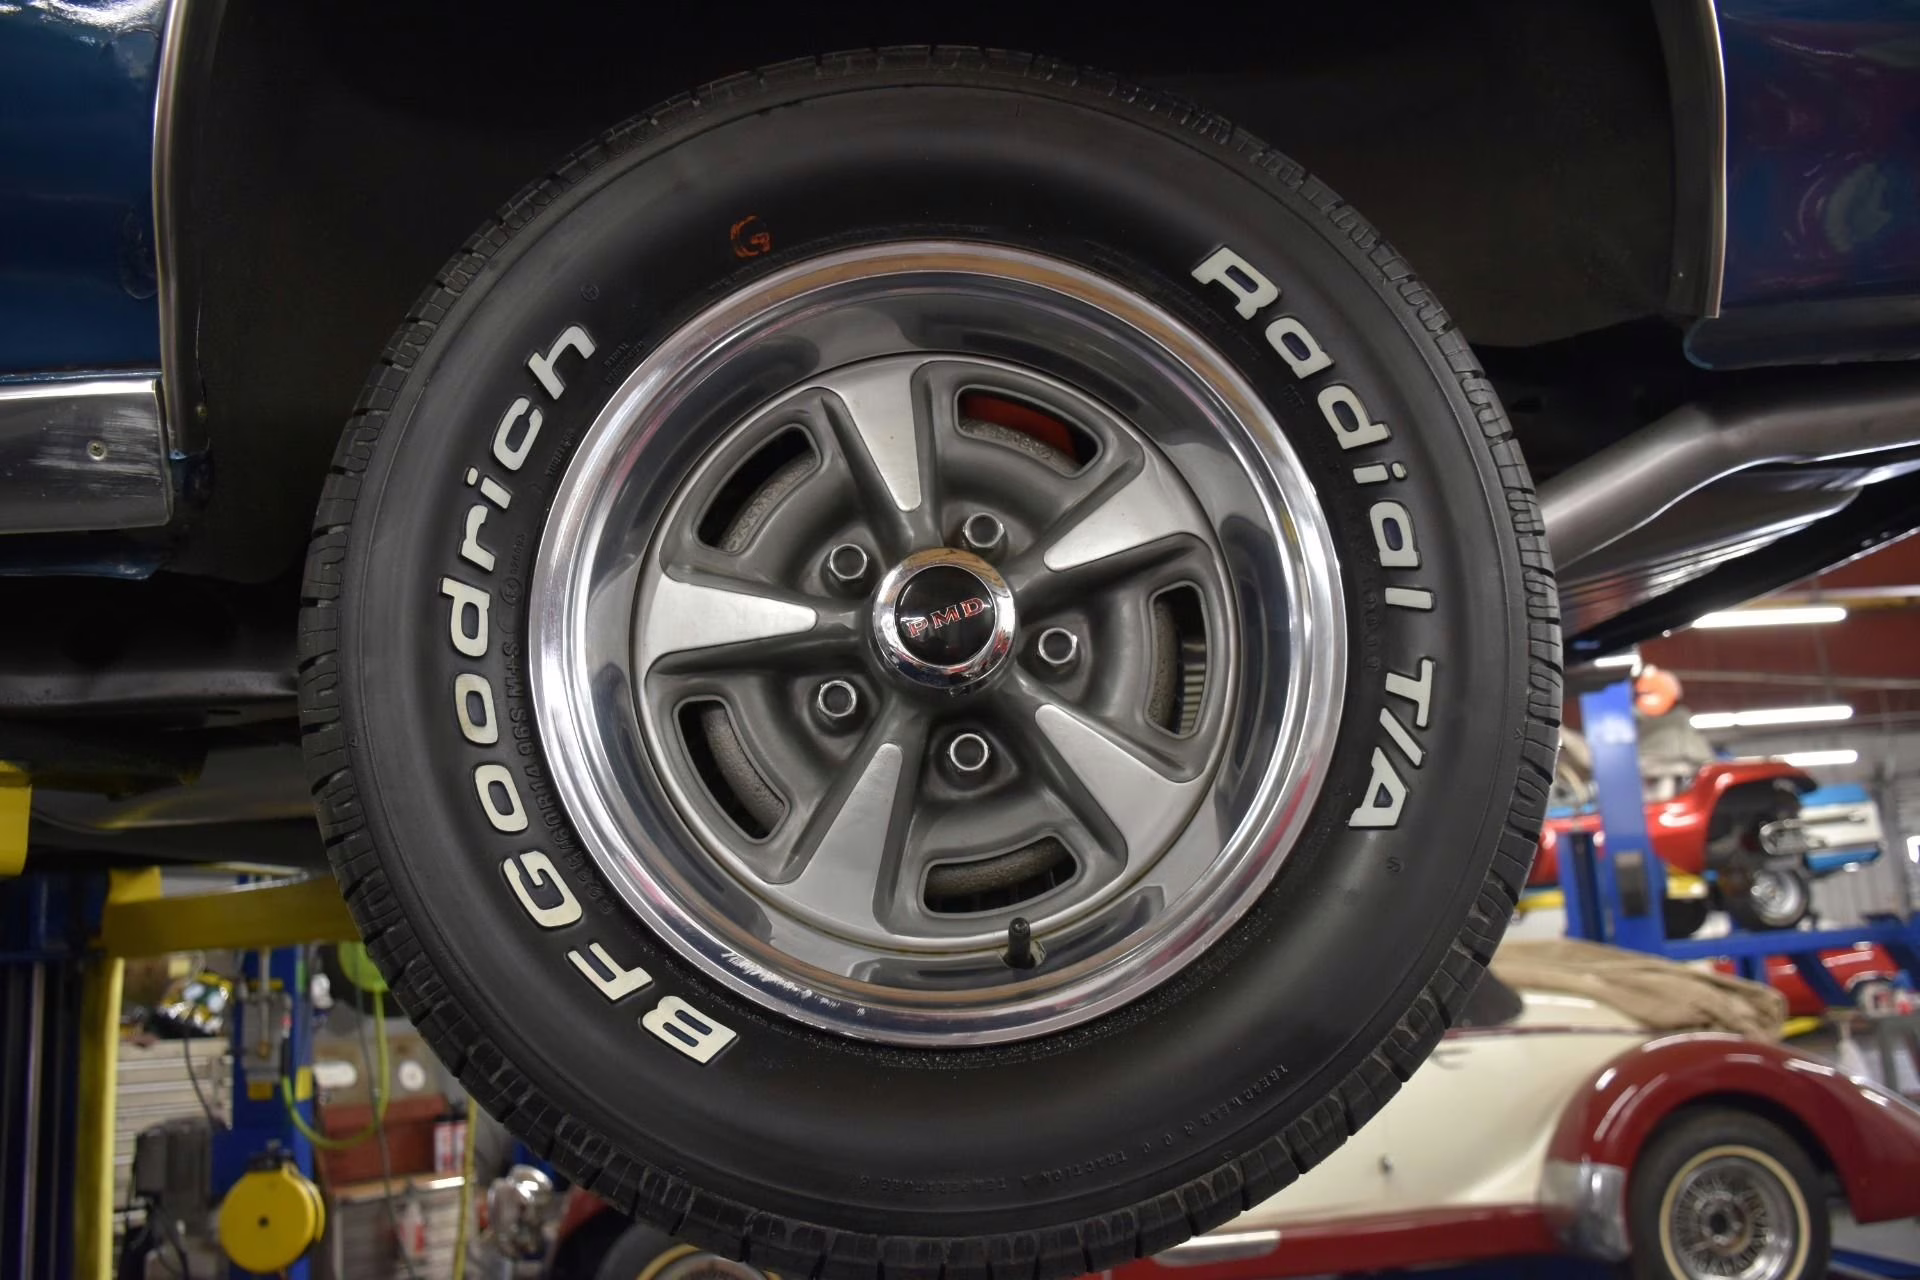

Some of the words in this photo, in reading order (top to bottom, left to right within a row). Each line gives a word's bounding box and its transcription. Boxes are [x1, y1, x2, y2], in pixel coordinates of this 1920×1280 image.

[1190, 246, 1434, 610] Radial
[1348, 658, 1434, 828] T/A
[905, 596, 986, 639] PMD
[442, 326, 738, 1064] BFGoodrich
[502, 641, 527, 699] M+S
[510, 707, 537, 757] 96S
